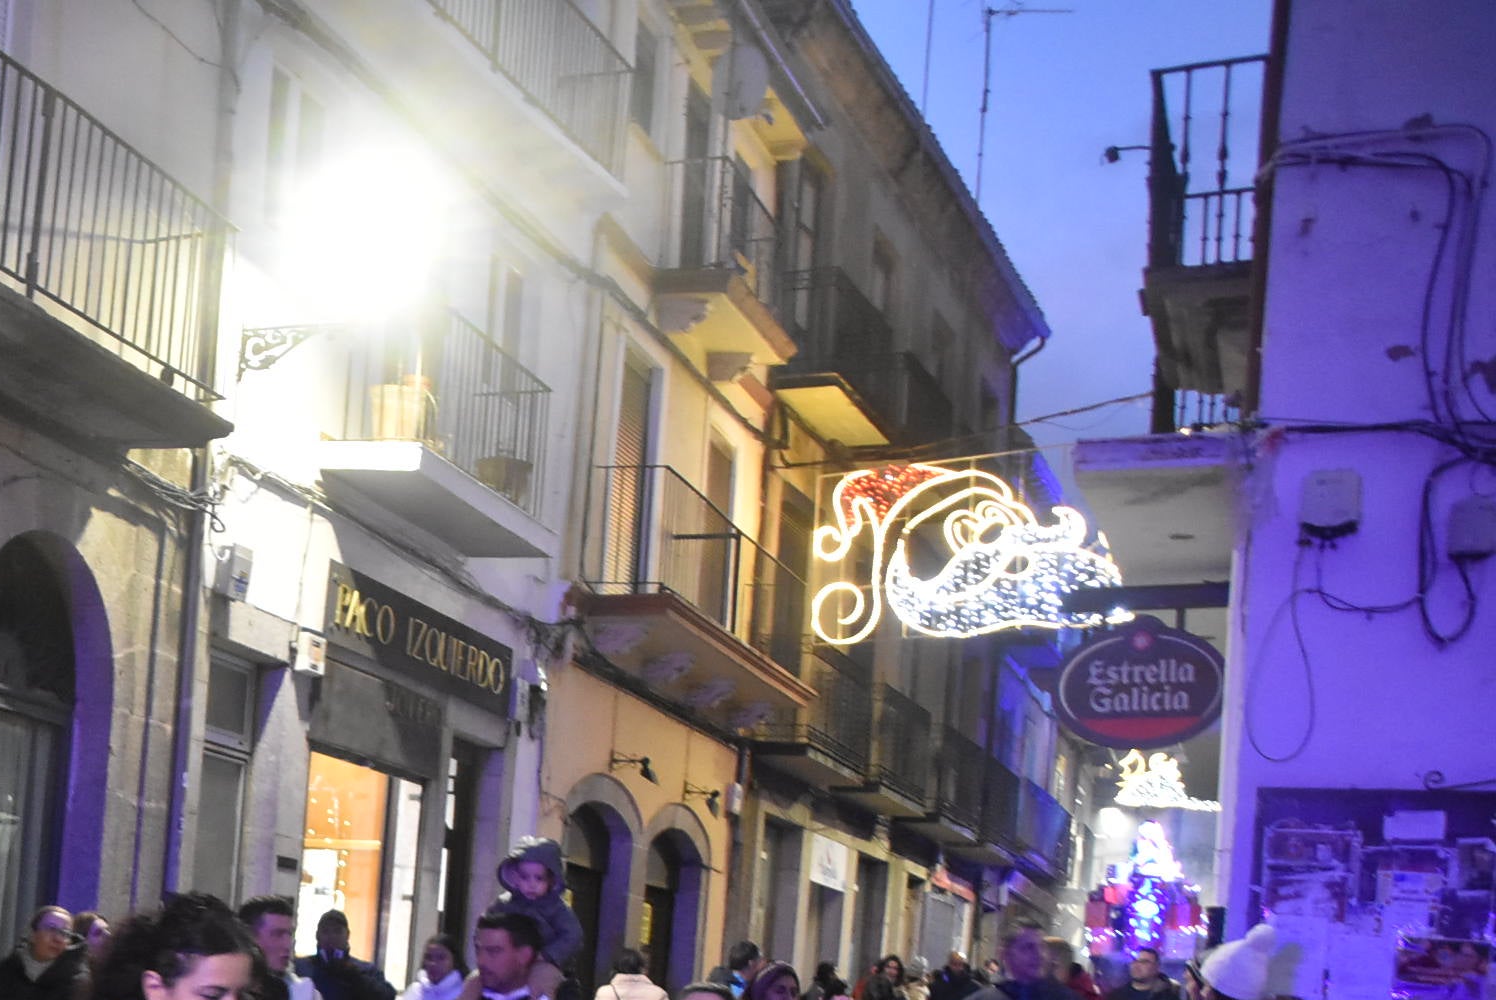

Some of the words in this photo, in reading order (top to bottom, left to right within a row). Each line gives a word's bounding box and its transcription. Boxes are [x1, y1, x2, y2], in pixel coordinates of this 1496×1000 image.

[333, 583, 396, 645] PACO
[406, 616, 504, 694] IZQUIERDO
[1087, 658, 1196, 685] Estrella
[1089, 685, 1190, 713] Galicia
